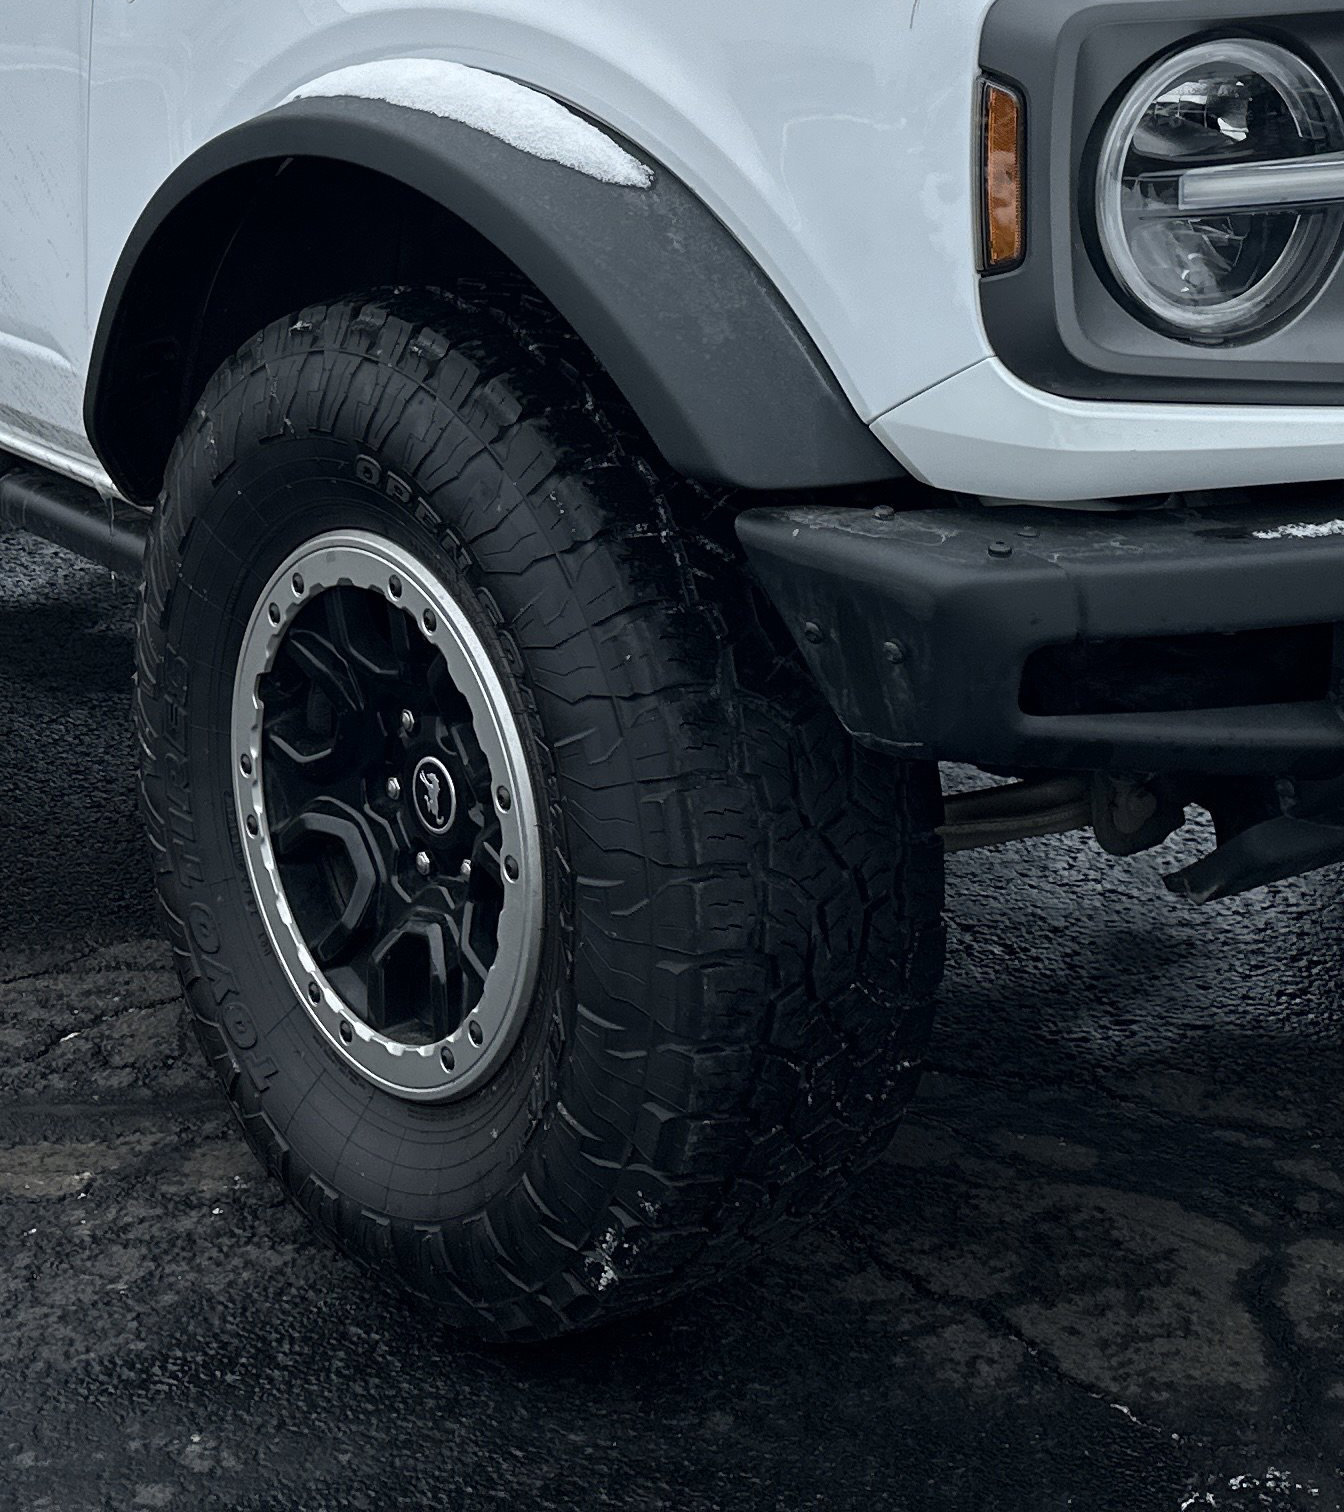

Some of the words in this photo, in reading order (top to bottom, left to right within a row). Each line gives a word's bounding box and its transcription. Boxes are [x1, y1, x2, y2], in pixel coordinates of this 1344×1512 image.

[355, 454, 473, 570] OPEN
[164, 642, 204, 888] TIRES
[188, 901, 279, 1094] TOYO
